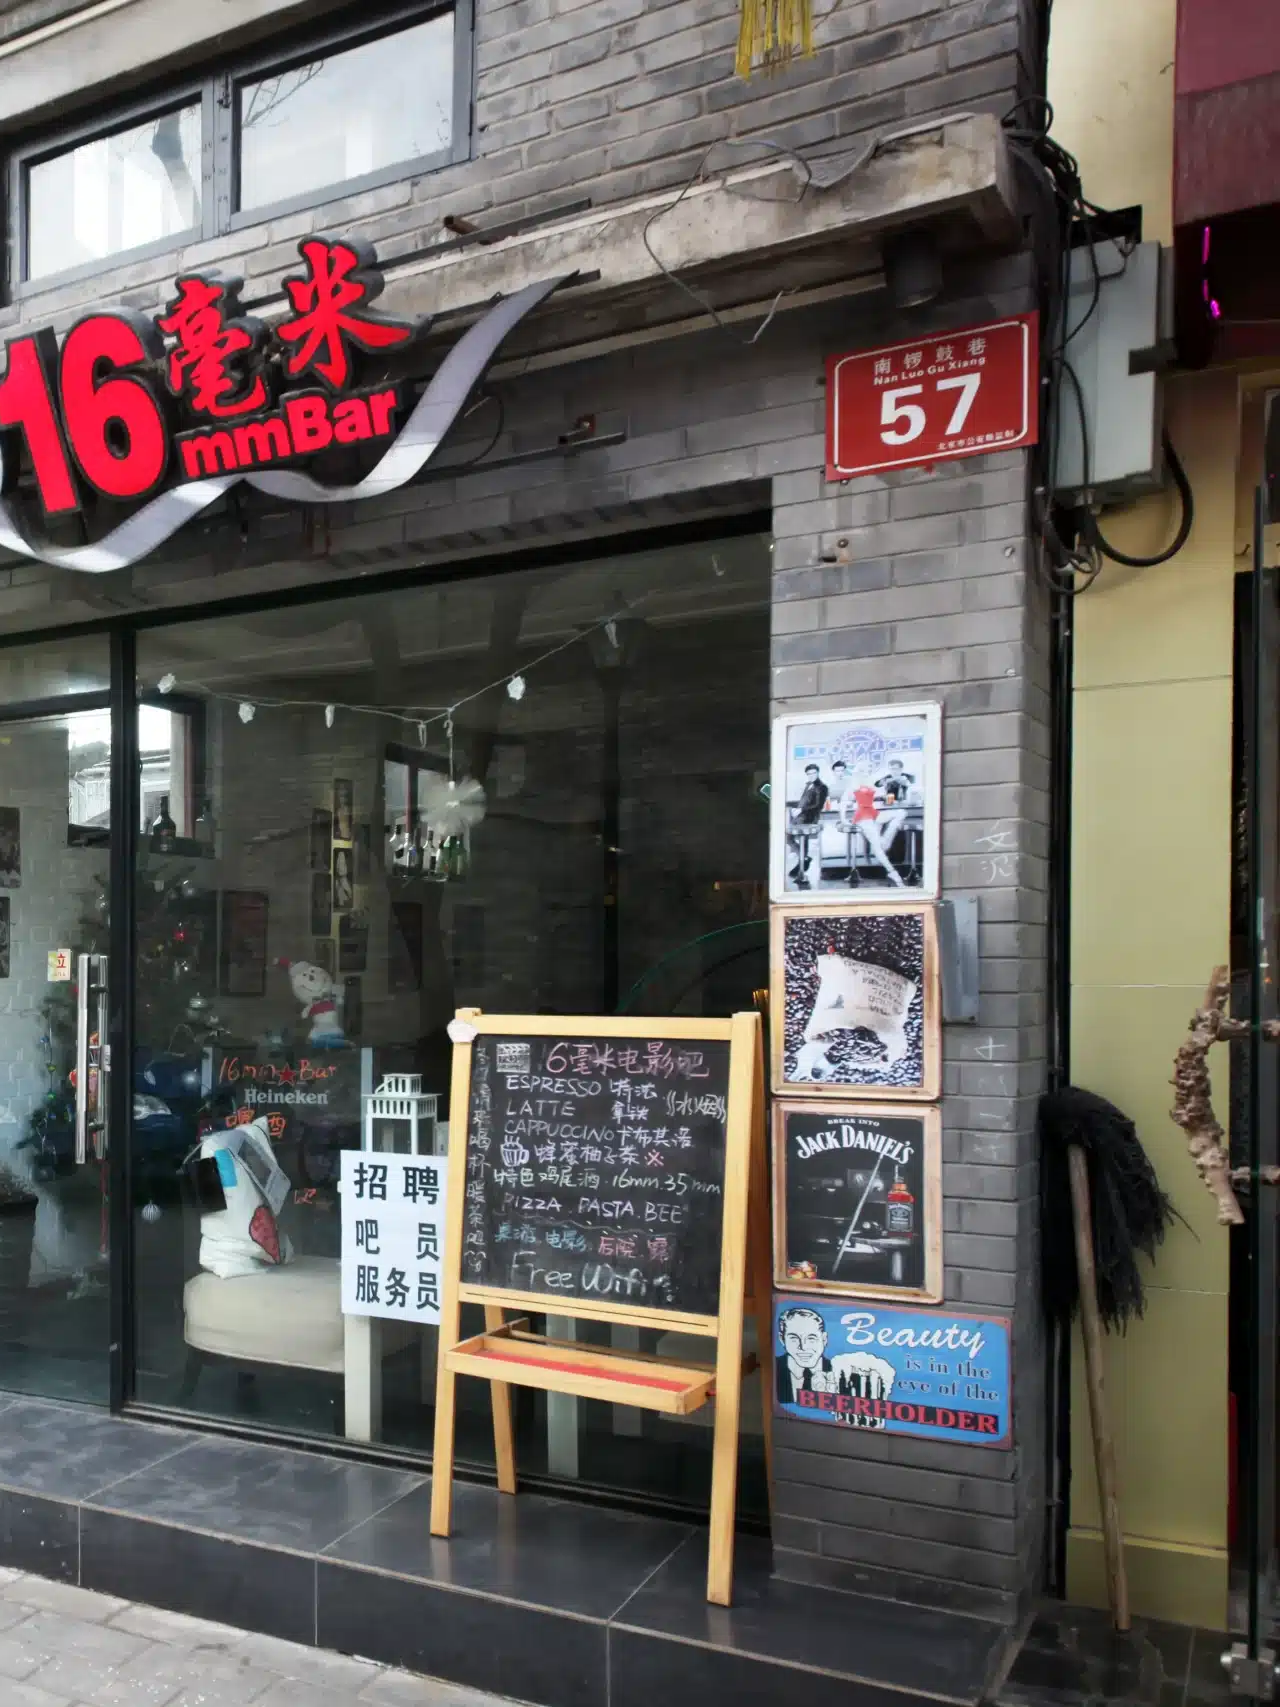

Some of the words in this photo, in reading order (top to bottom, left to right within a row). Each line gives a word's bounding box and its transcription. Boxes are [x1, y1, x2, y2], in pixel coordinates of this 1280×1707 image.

[873, 337, 987, 376] 南锣鼓巷
[873, 374, 898, 387] Nan
[901, 368, 924, 381] Luo
[927, 364, 946, 376] Gu
[948, 356, 987, 370] Xiang
[879, 371, 982, 446] 57
[180, 387, 398, 480] mmBar
[299, 1059, 338, 1080] Bar
[244, 1087, 329, 1105] Heineken
[506, 1075, 602, 1097] ESPRESSO
[506, 1099, 576, 1117] LATTE
[611, 1101, 649, 1124] 拿铁
[504, 1119, 615, 1143] CAPPUCCINO
[858, 1119, 880, 1127] INTO
[534, 1140, 640, 1165] 蜂蜜柚子茶
[795, 1130, 841, 1159] JACK
[841, 1124, 915, 1165] DANIEL'S
[353, 1161, 440, 1205] 招聘
[493, 1166, 600, 1190] 特色鸡尾酒
[578, 1196, 635, 1218] PASTA
[355, 1218, 440, 1262] 吧员
[511, 1250, 575, 1289] Free
[355, 1265, 441, 1312] 服务员
[840, 1312, 986, 1359] Beauty
[906, 1354, 921, 1370] is
[930, 1356, 949, 1375] in
[957, 1360, 992, 1380] the
[898, 1380, 931, 1395] eye
[938, 1380, 960, 1397] of
[964, 1382, 999, 1401] the
[797, 1390, 999, 1435] BEERHOLDER
